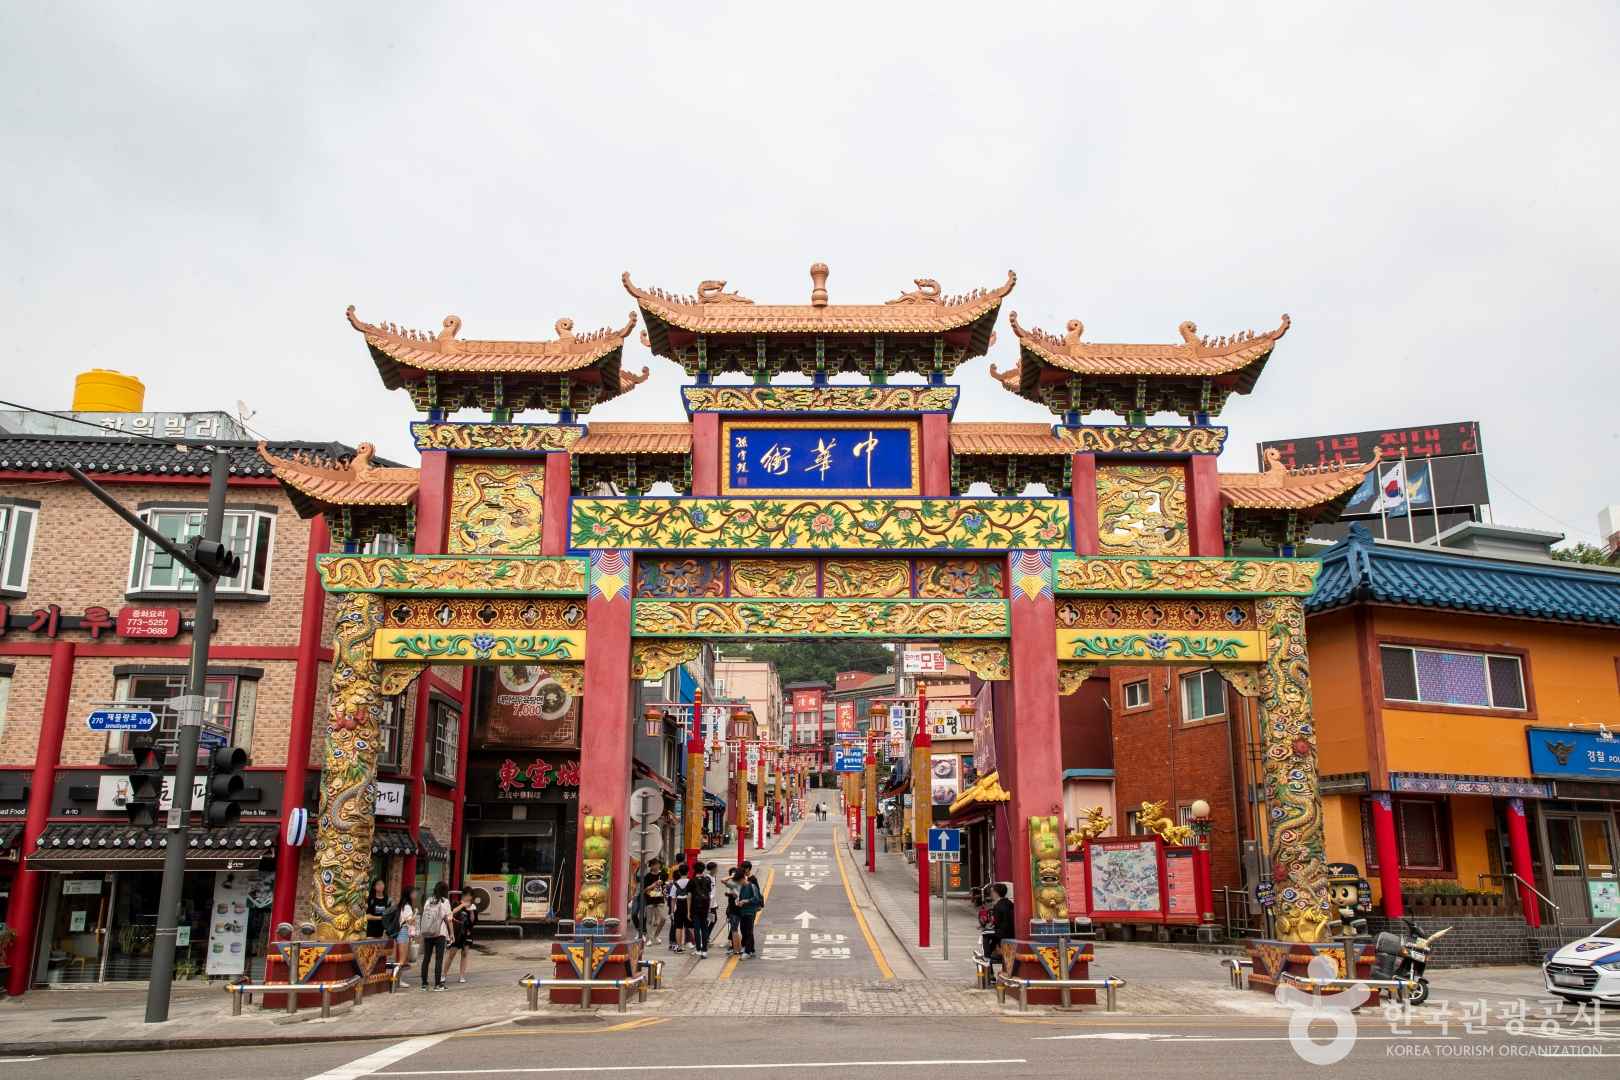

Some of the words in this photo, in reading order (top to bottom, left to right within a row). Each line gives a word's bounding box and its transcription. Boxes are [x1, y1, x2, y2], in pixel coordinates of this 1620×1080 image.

[0, 602, 112, 639] 기루
[127, 618, 169, 626] 773-5257
[91, 717, 104, 725] 270
[139, 717, 152, 725] 266
[1587, 750, 1605, 763] 경찰
